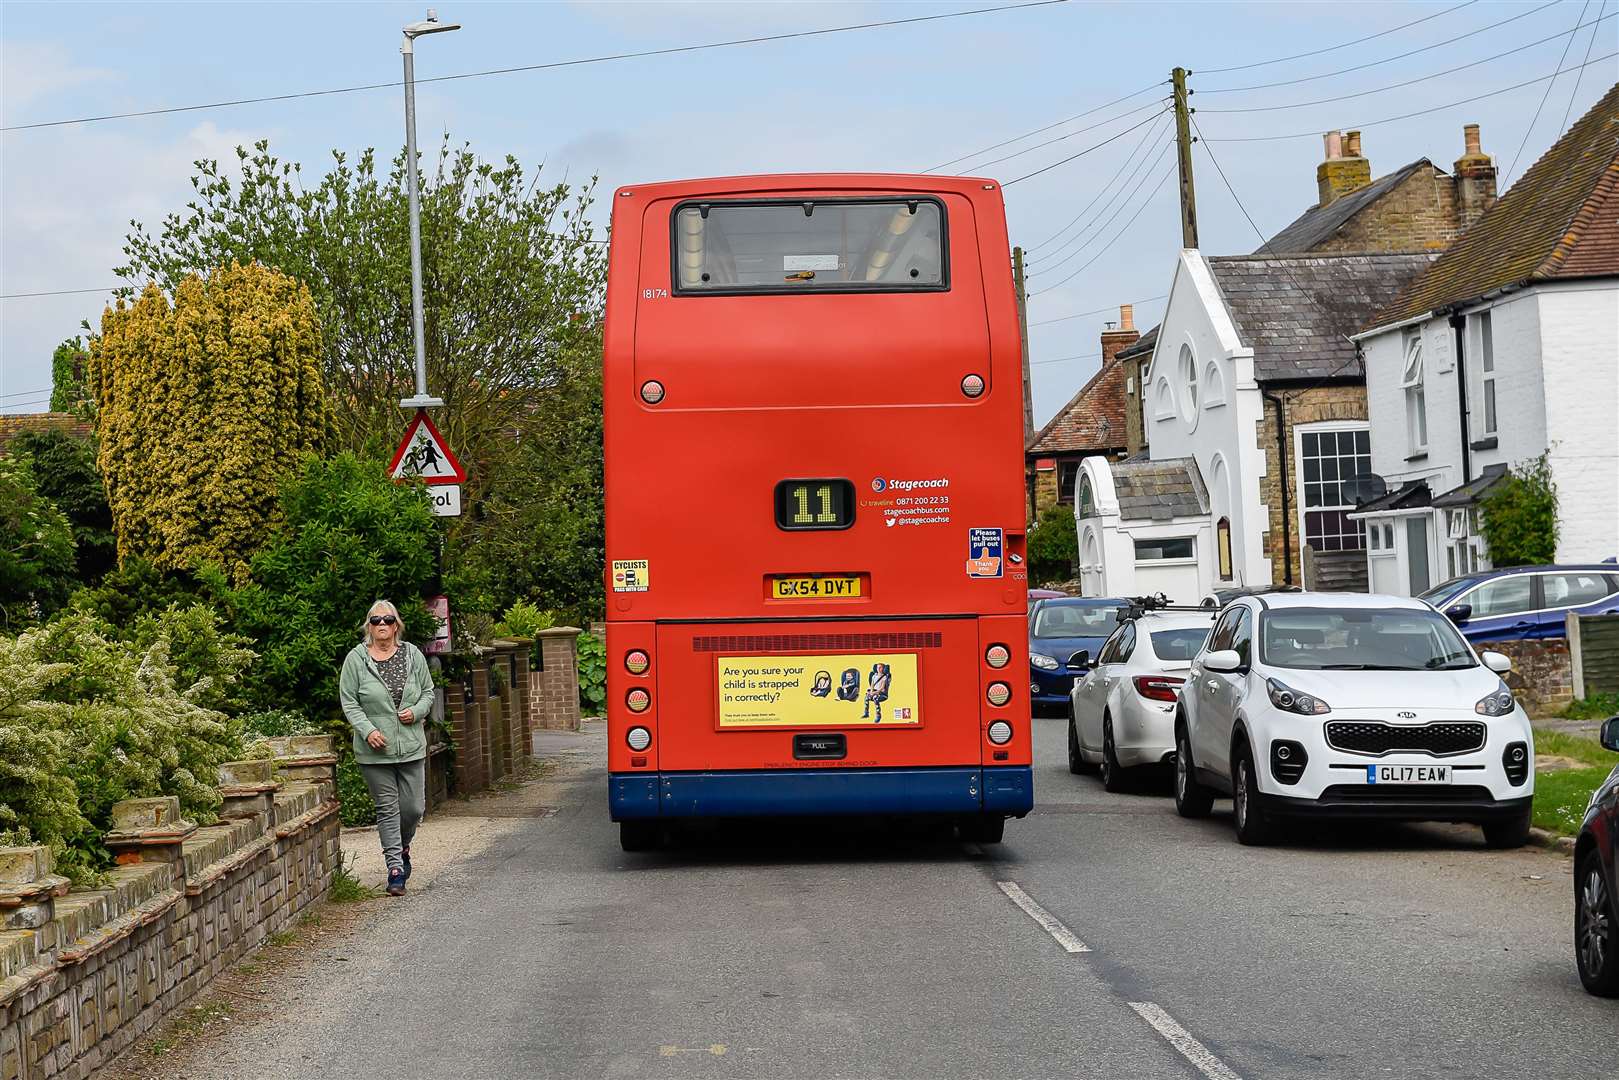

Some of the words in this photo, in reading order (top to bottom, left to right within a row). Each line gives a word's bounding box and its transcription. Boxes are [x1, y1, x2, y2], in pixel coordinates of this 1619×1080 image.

[643, 289, 667, 299] 18174
[889, 478, 949, 491] Stagecoach
[793, 486, 837, 523] 11
[868, 499, 894, 507] traveline
[896, 498, 913, 506] 0871
[914, 497, 929, 505] 200
[929, 496, 938, 504] 22
[939, 496, 949, 504] 33
[883, 507, 950, 517] stagecoachbus.com
[898, 516, 950, 526] @stagecoachse
[614, 561, 647, 569] CYCLISTS
[779, 581, 819, 595] GX54
[824, 580, 854, 594] DVT
[724, 667, 740, 675] Are
[742, 668, 759, 678] you
[783, 667, 804, 677] your
[724, 680, 746, 688] child
[748, 680, 756, 688] is
[758, 678, 799, 690] strapped
[724, 693, 733, 702] in
[735, 692, 781, 703] correctly?
[1381, 767, 1414, 781] GL17
[1418, 767, 1446, 781] EAW
